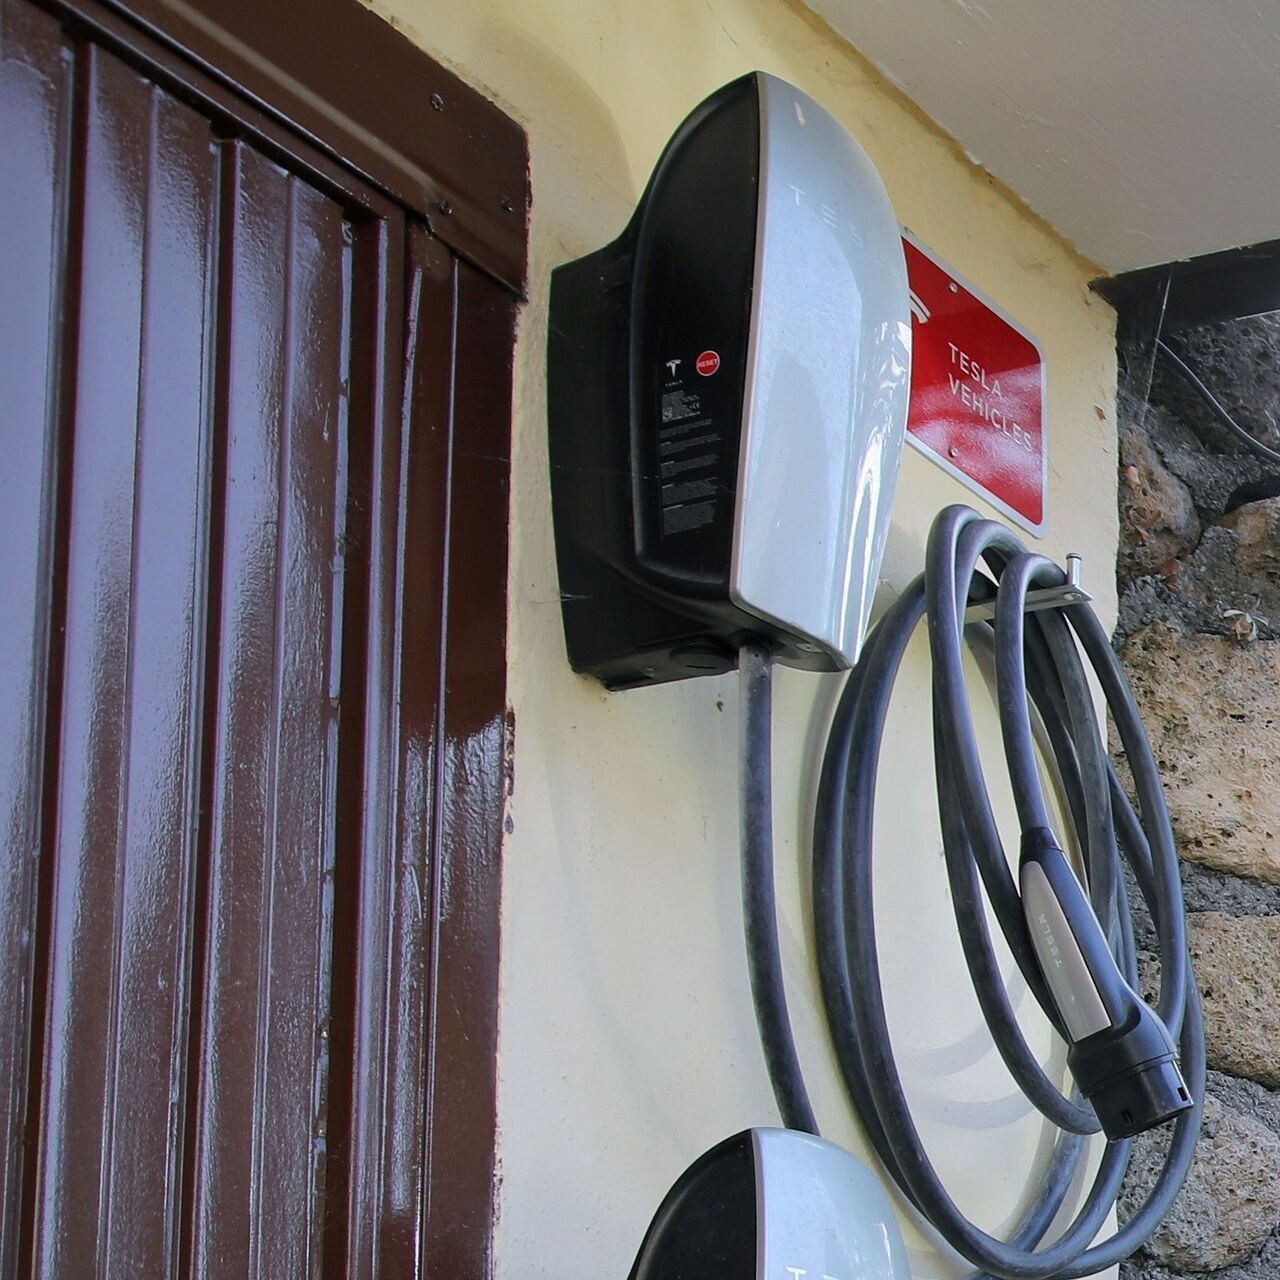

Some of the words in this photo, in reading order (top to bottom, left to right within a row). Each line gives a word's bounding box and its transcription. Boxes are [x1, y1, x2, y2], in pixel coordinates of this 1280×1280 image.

[697, 358, 718, 368] RESET
[947, 341, 1003, 401] TESLA
[947, 373, 1033, 452] VEHICLES
